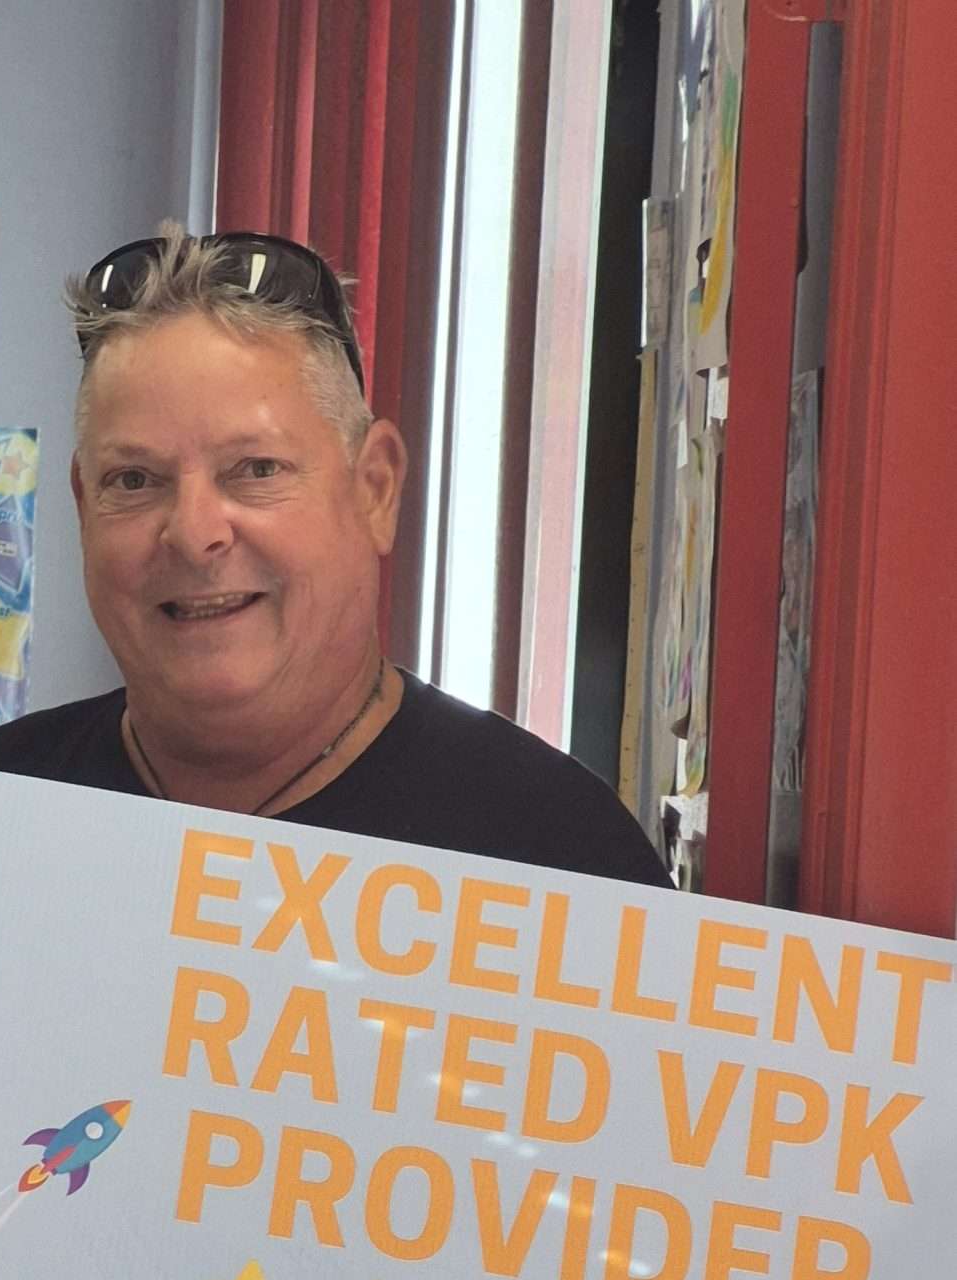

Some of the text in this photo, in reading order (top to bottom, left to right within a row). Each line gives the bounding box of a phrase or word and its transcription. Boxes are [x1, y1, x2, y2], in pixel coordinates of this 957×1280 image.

[169, 828, 954, 1066] EXCELLENT
[162, 965, 926, 1206] RATED VPK
